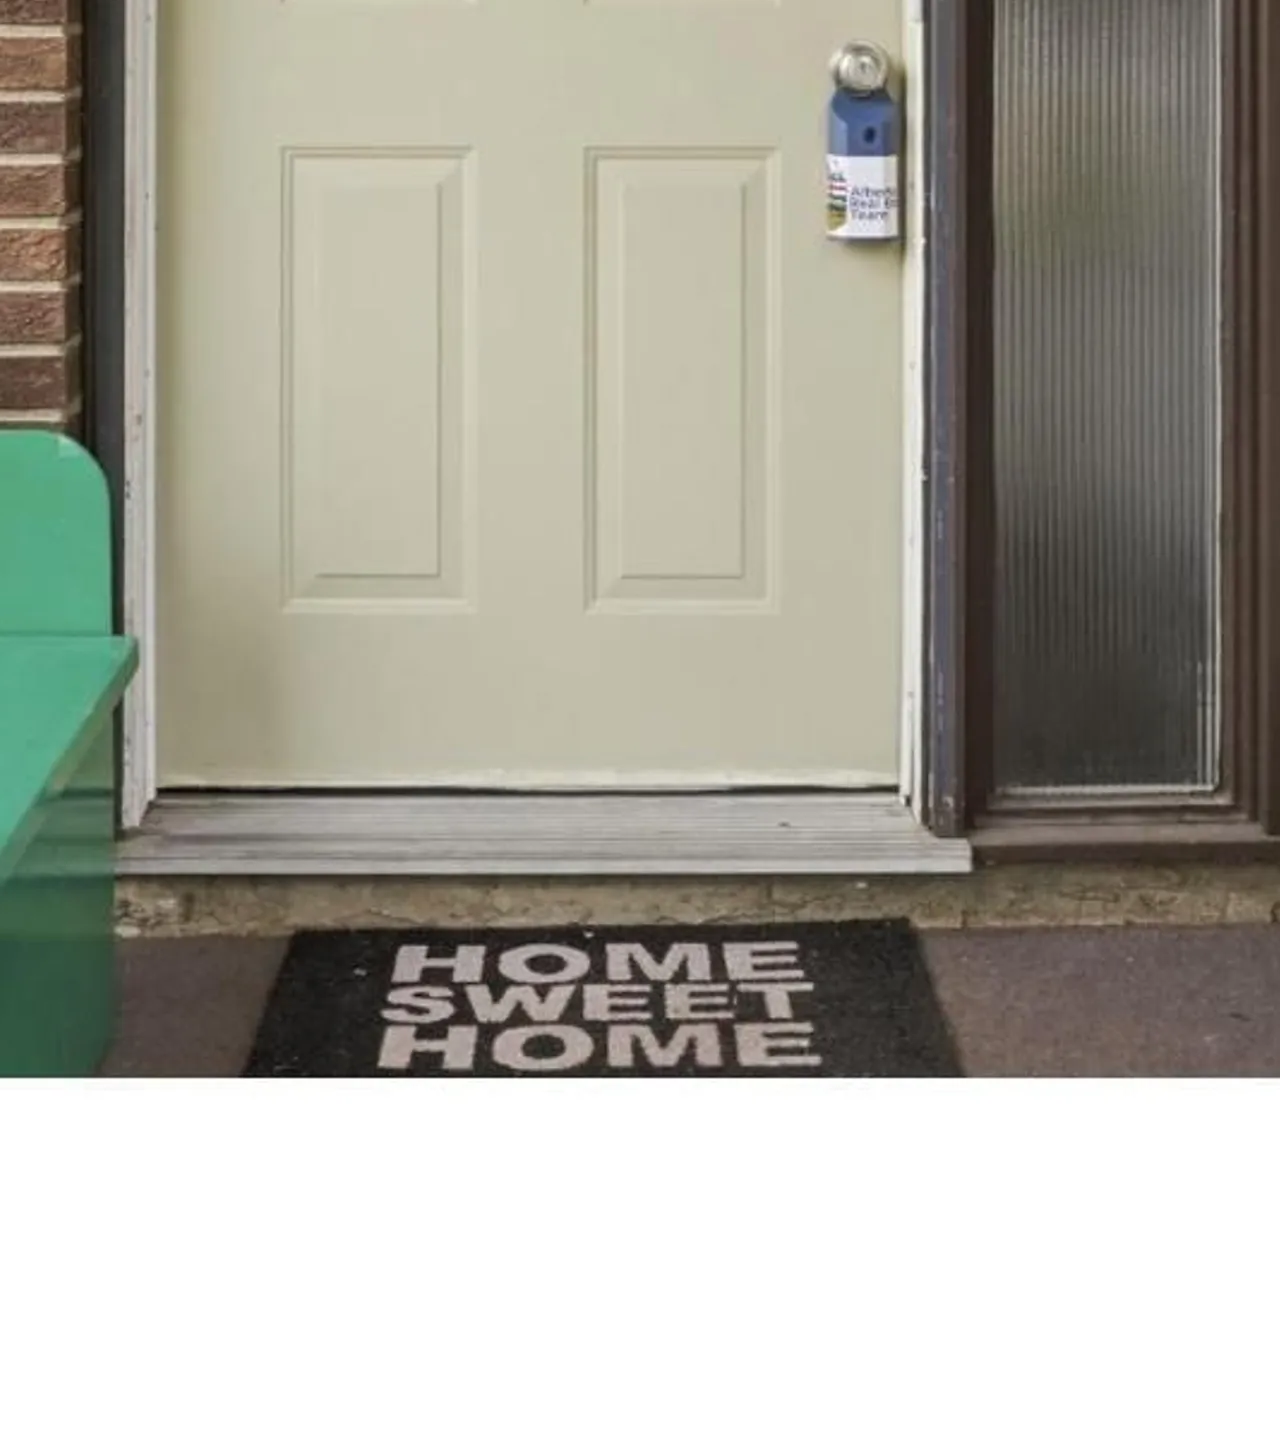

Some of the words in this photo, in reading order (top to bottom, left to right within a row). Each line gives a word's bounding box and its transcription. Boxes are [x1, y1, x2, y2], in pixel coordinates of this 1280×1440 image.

[391, 941, 806, 984] HOME
[380, 982, 815, 1023] SWEET
[377, 1022, 822, 1071] HOME
